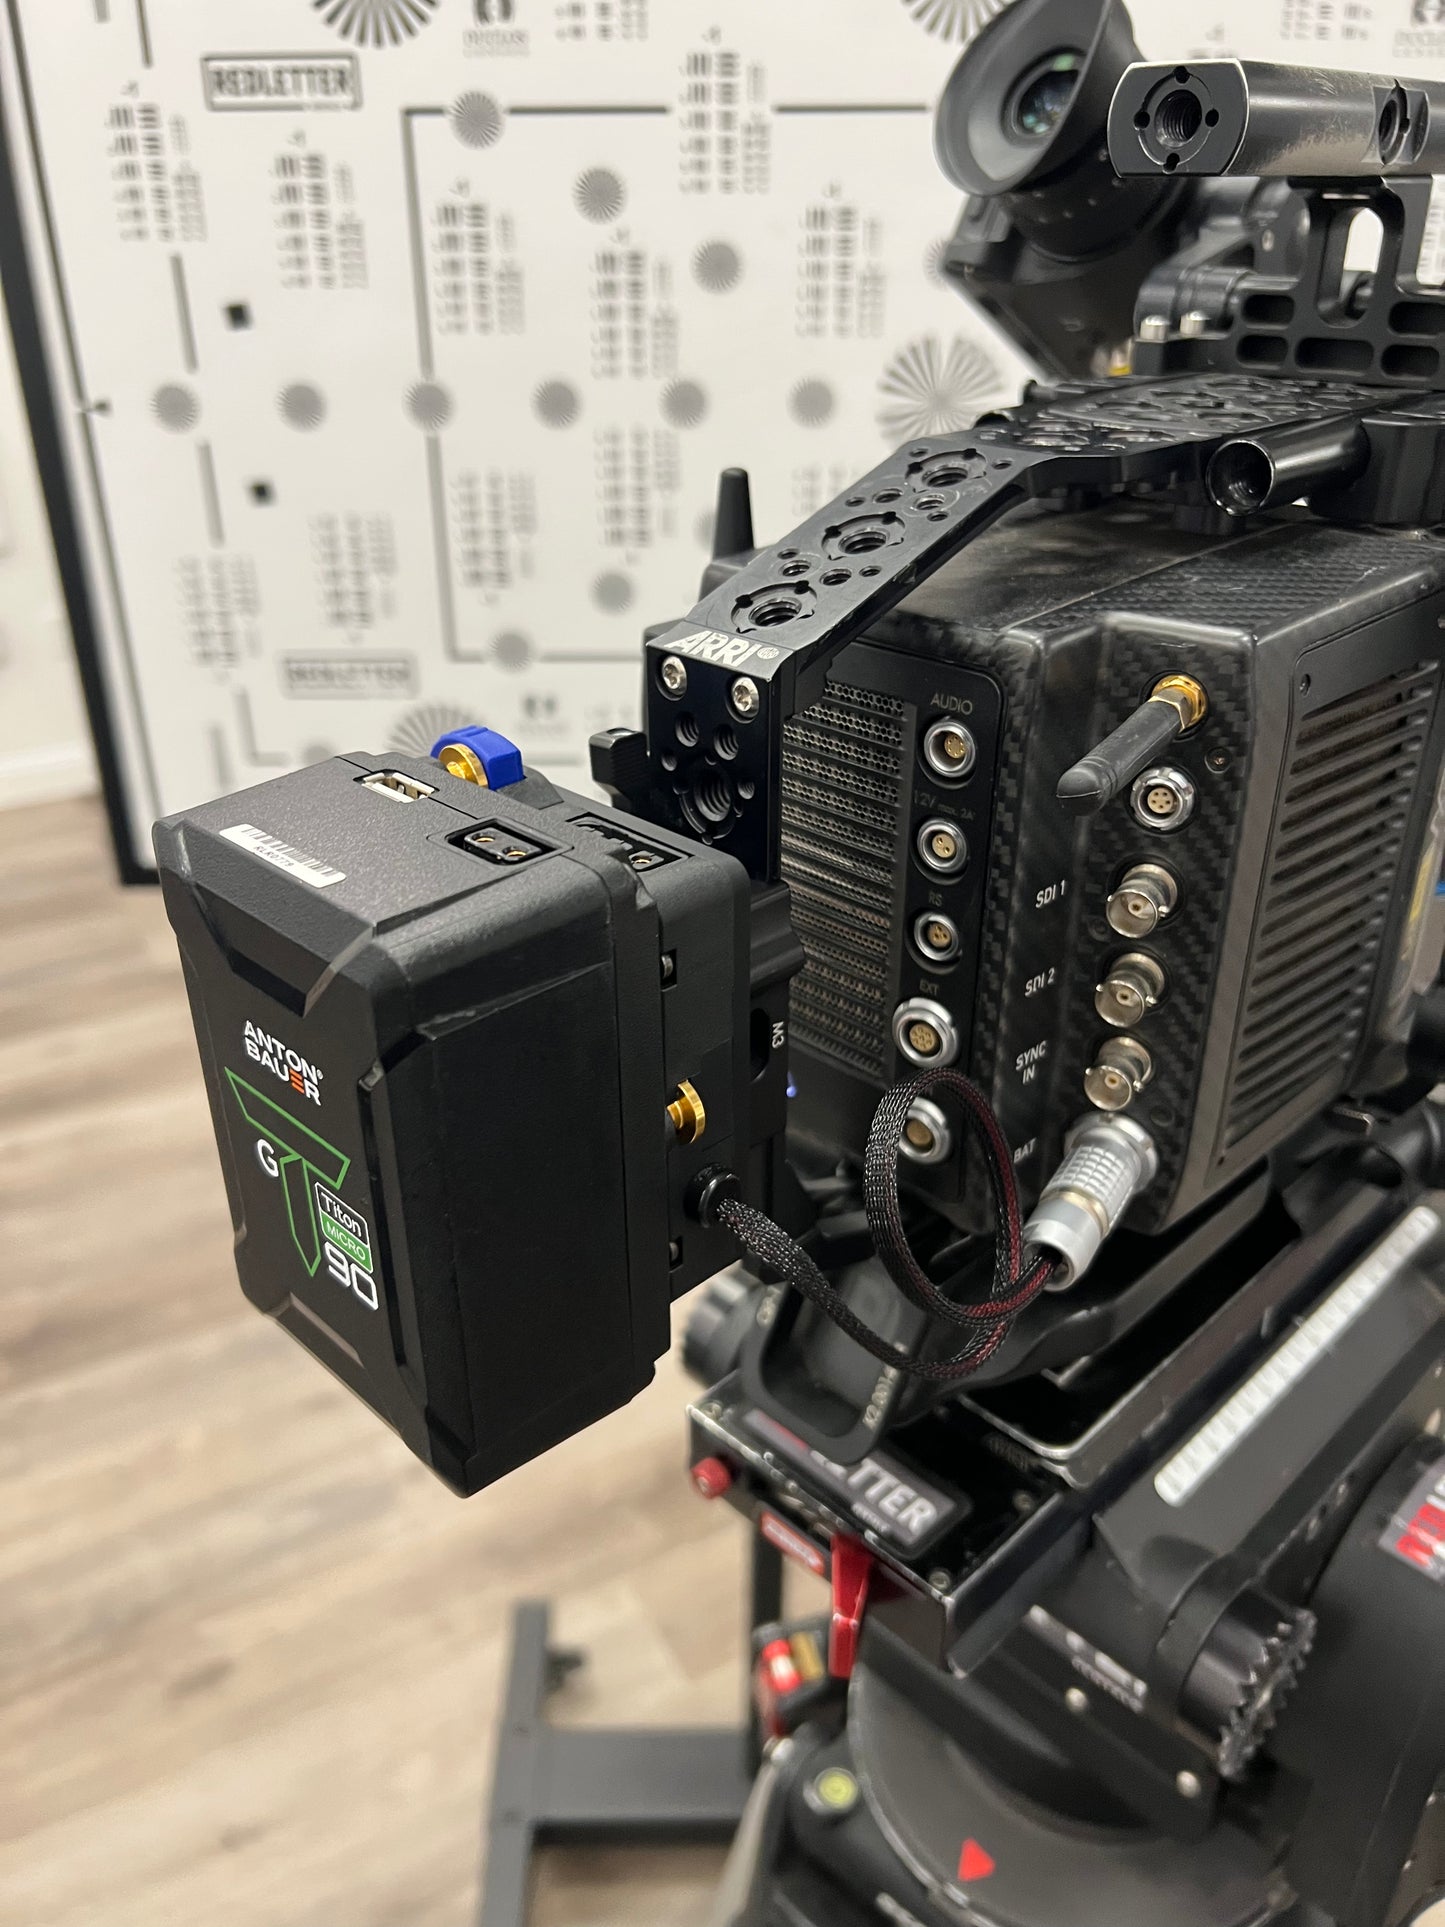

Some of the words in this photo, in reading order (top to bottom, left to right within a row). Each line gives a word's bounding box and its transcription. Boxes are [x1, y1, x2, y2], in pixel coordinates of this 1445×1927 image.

[664, 630, 762, 667] ARRI
[930, 692, 973, 715] AUDIO
[928, 891, 943, 907] RS
[1035, 884, 1057, 908] SDI
[1060, 879, 1066, 896] 1
[920, 978, 939, 996] EXT
[1024, 972, 1045, 997] SDI
[1047, 967, 1056, 985] 2
[772, 1021, 785, 1049] M3
[1015, 1040, 1047, 1071] SYNC
[244, 1036, 322, 1106] BAUER
[1022, 1063, 1036, 1085] IN
[1013, 1137, 1037, 1164] BAT
[320, 1191, 362, 1238] Titon
[326, 1220, 366, 1261] MICRO
[323, 1241, 378, 1311] 90
